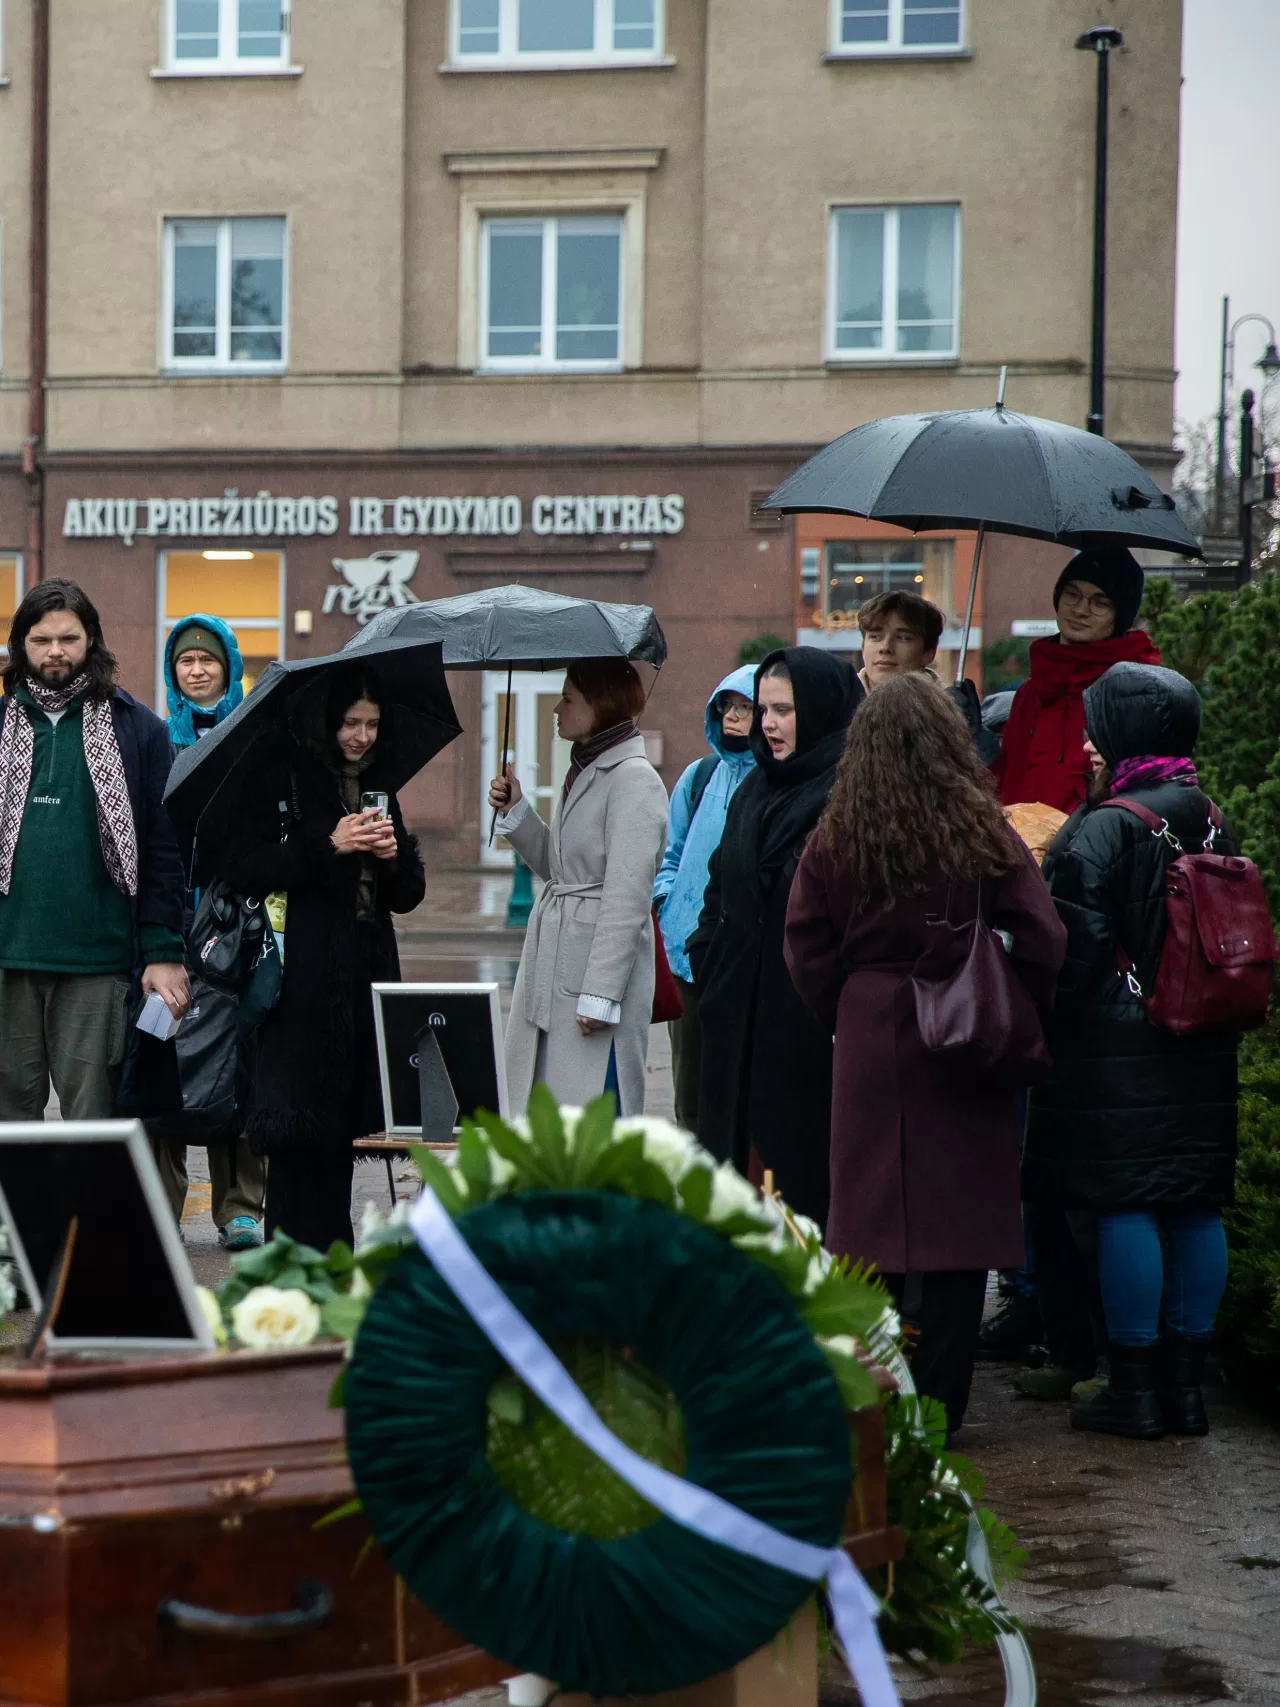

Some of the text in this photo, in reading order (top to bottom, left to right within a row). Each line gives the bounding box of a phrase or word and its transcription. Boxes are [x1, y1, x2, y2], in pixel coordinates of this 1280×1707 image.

[63, 488, 684, 546] AKIŲ PRIEŽIŪROS IR GYDYMO CENTRAS
